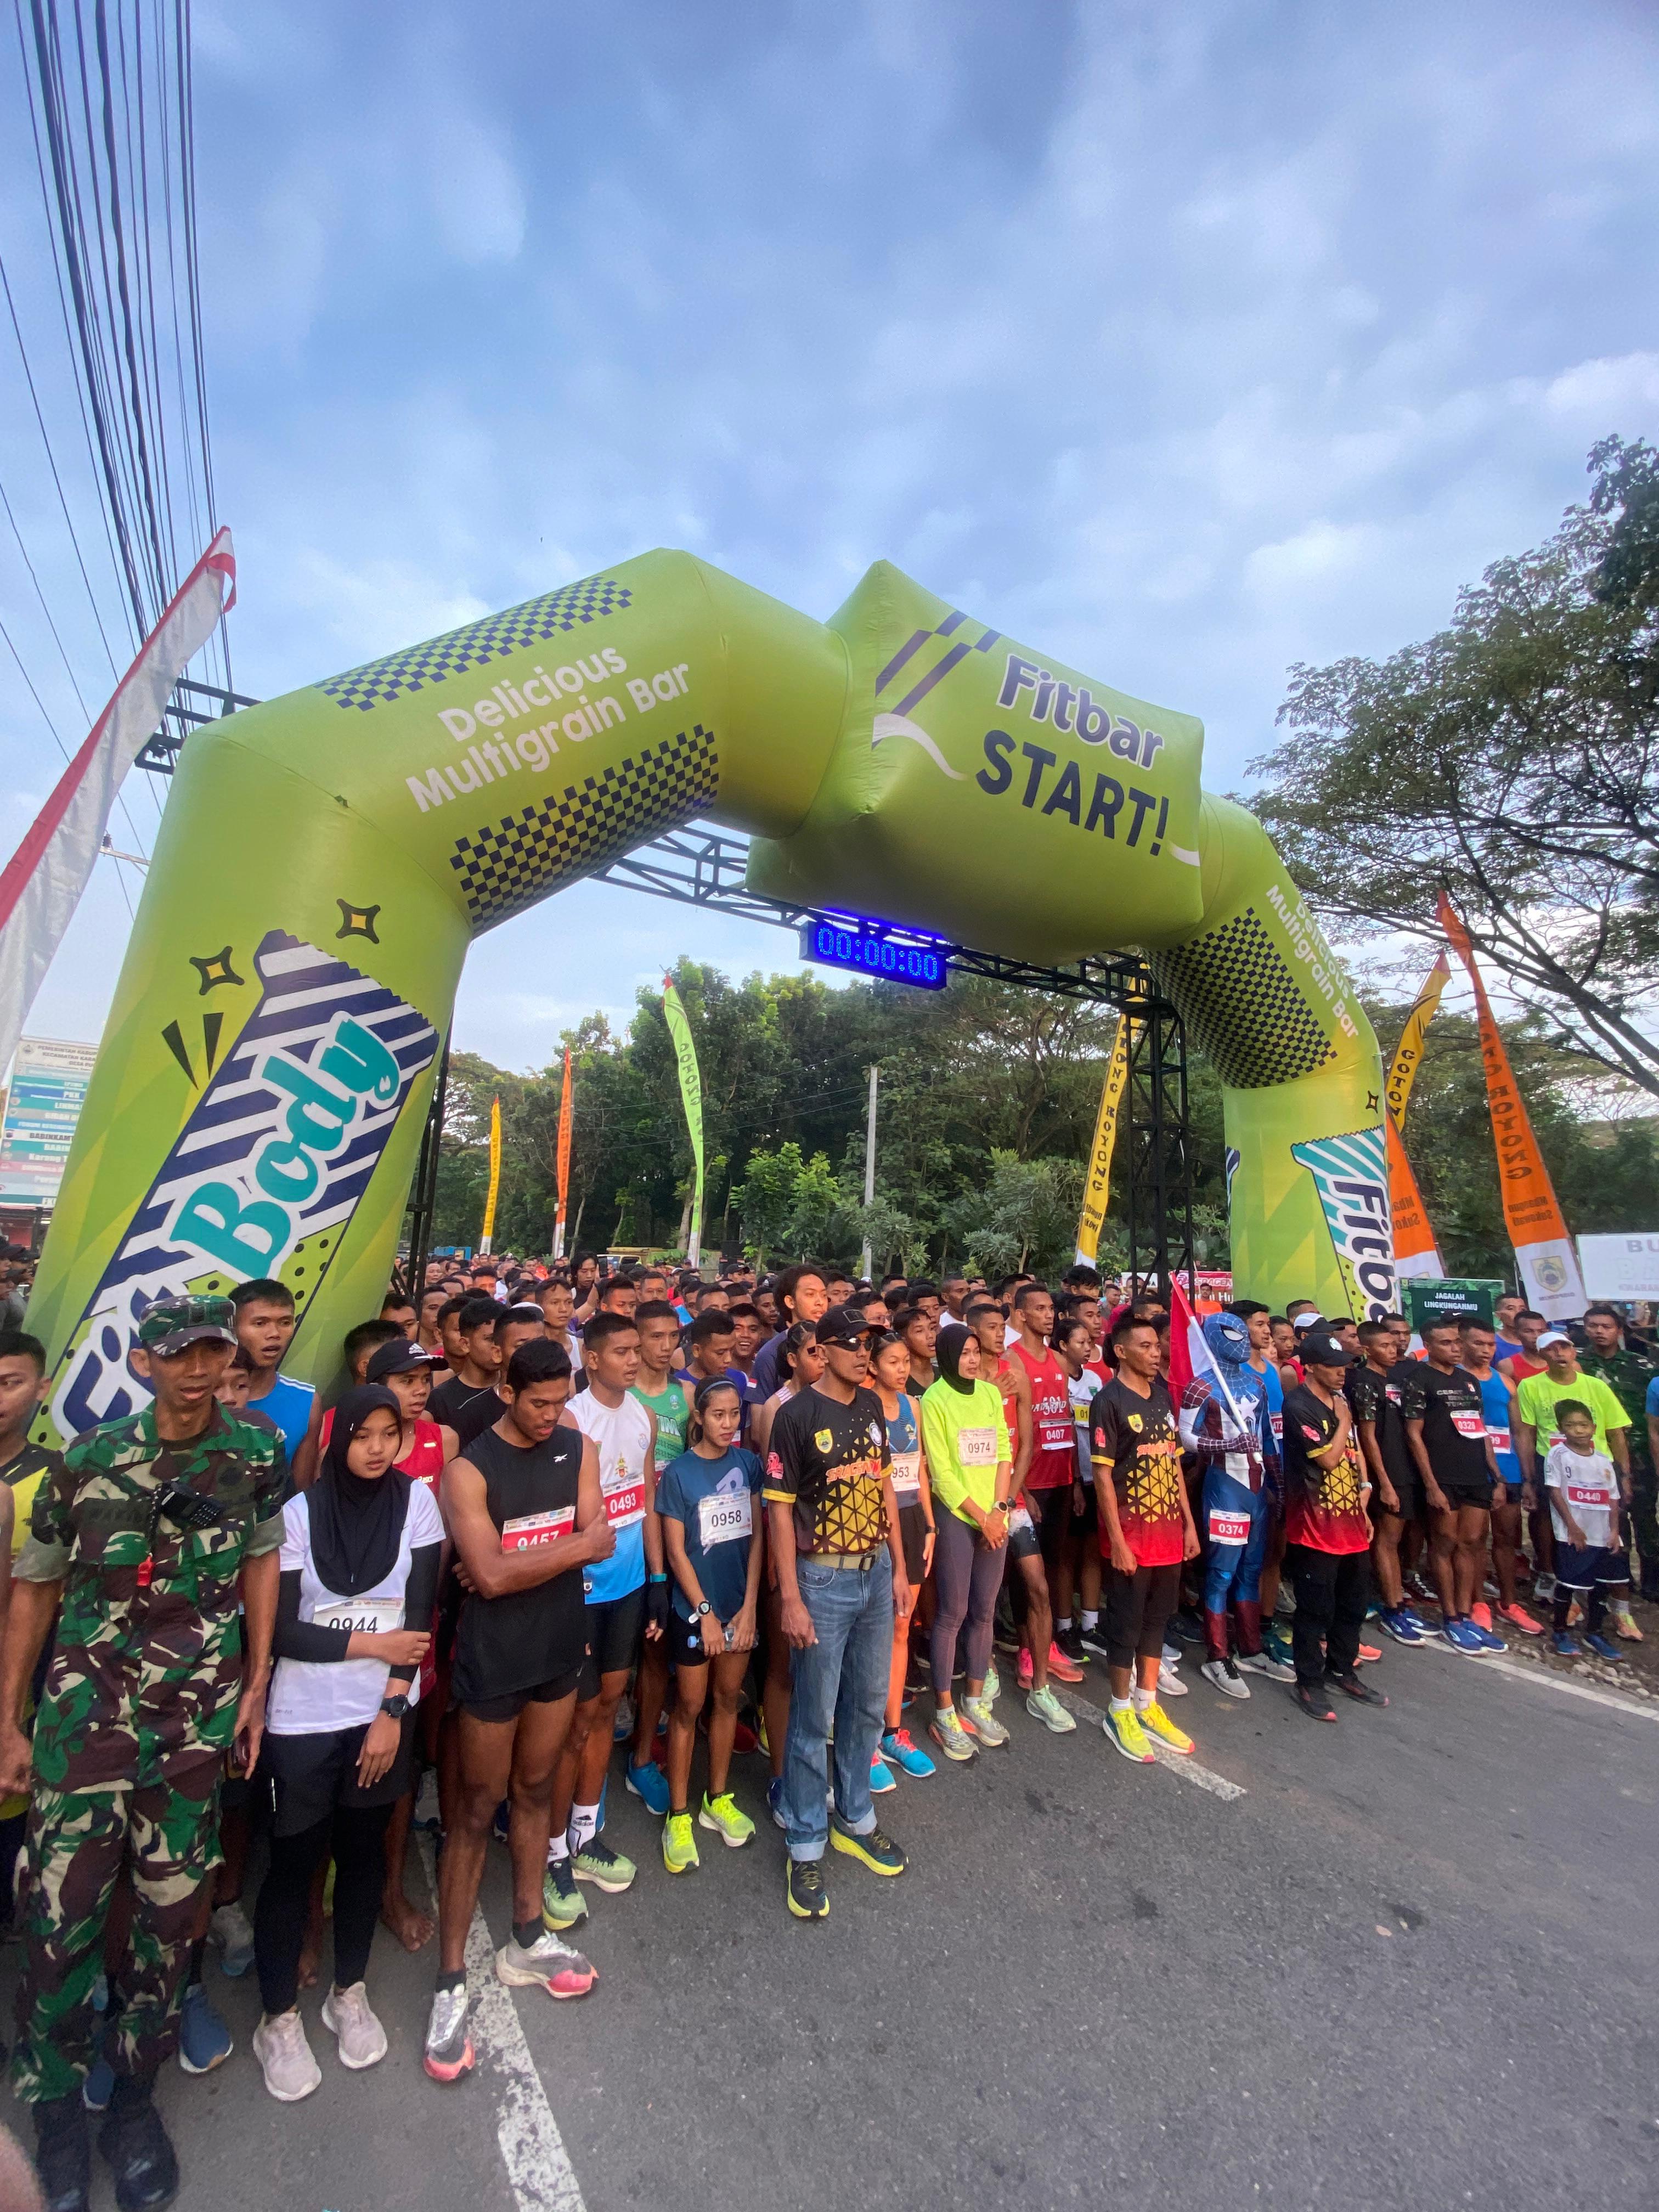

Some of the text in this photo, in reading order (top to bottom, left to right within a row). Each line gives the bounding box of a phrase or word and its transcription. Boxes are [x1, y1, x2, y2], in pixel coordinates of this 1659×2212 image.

[437, 647, 627, 742] Delicious
[996, 653, 1165, 770] Fitbar
[405, 663, 689, 812] Multigrain Bar
[975, 730, 1169, 856] START!
[819, 928, 937, 980] 00:00:00
[1266, 884, 1358, 1037] Multigrain Bar
[1296, 901, 1349, 998] Delicious
[170, 1019, 400, 1278] Body
[1092, 1105, 1115, 1191] ROYONG
[1424, 1301, 1477, 1311] LINGKUNGANMU
[968, 1442, 990, 1453] 0974
[1046, 1429, 1064, 1440] 0407
[1566, 1466, 1572, 1479] 9
[610, 1492, 636, 1514] 0493
[712, 1510, 742, 1527] 0958
[1218, 1523, 1244, 1535] 0374
[329, 1617, 377, 1633] 0944
